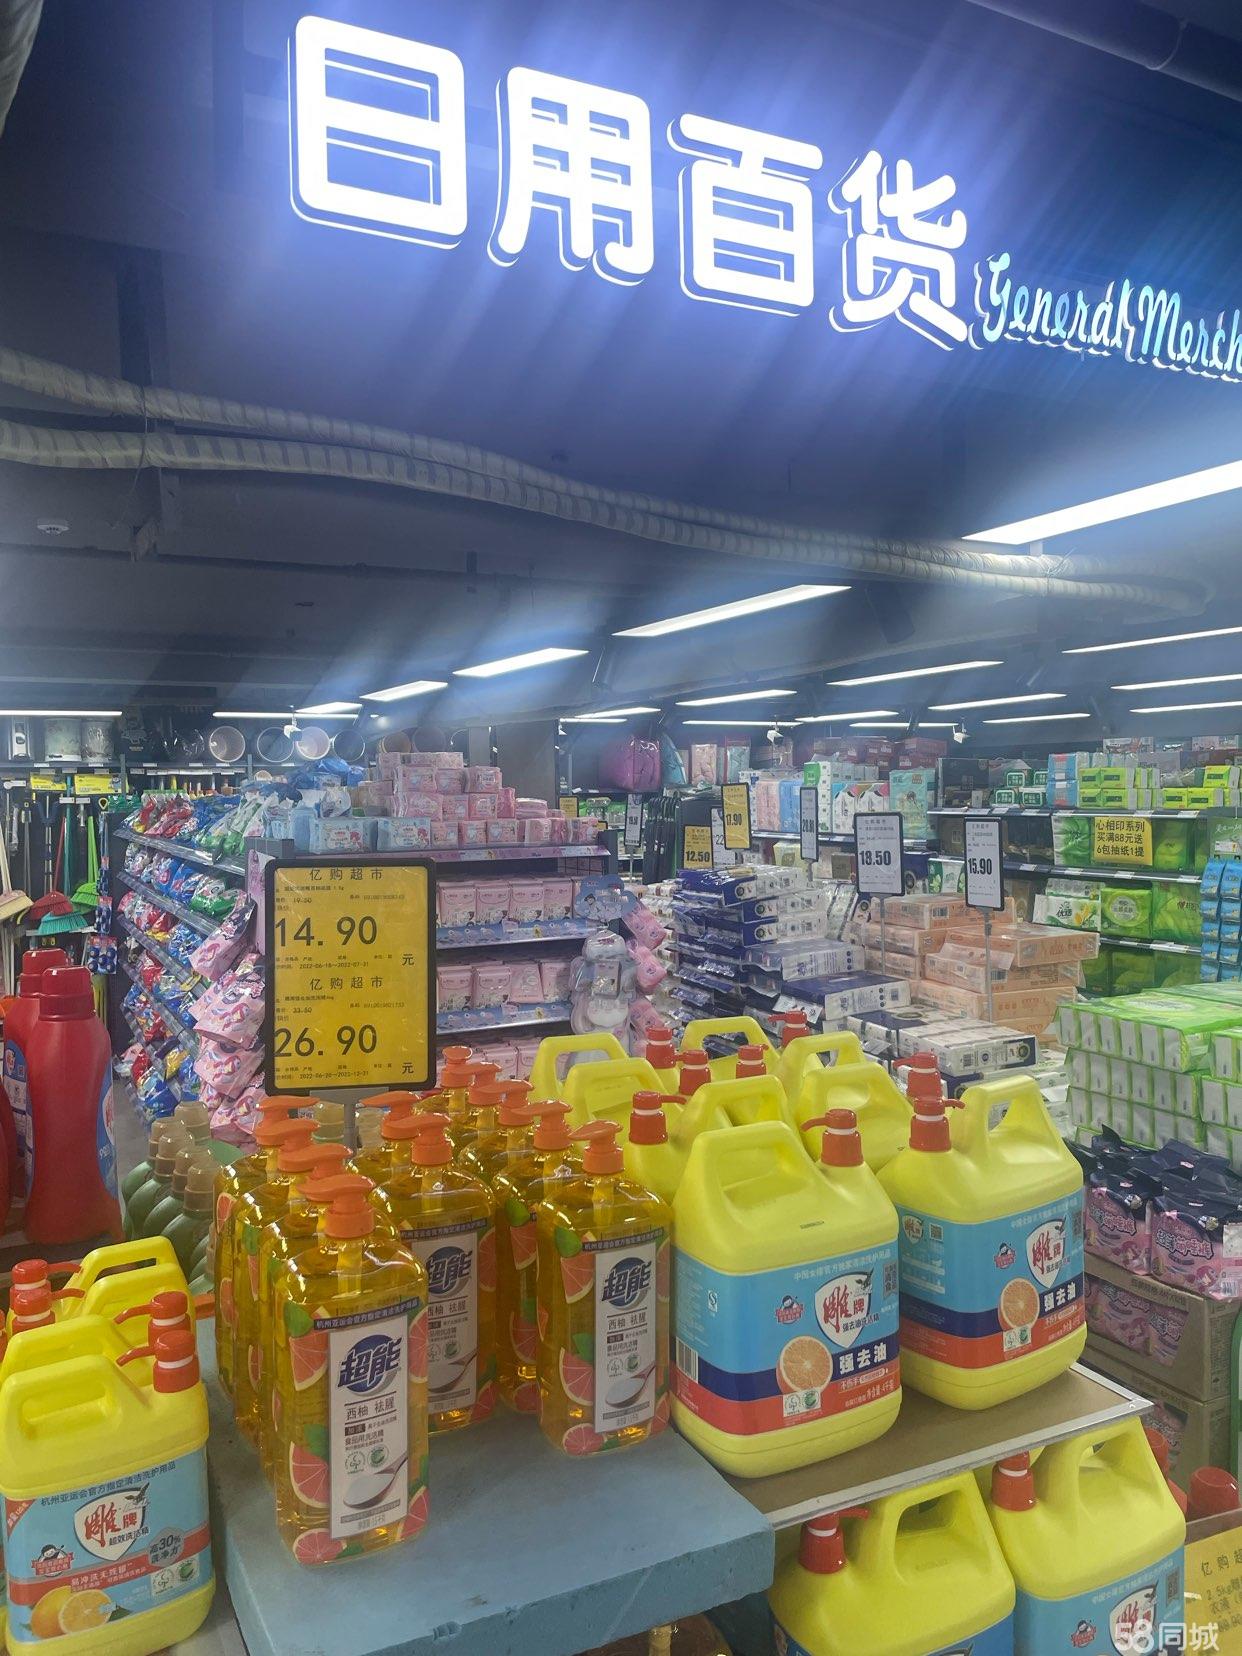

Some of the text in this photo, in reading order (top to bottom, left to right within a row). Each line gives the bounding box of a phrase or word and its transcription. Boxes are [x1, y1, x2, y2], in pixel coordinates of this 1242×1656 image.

[290, 15, 968, 350] 日用百货
[982, 252, 1130, 349] General
[1096, 820, 1145, 832] 心相印系列
[1097, 832, 1143, 844] 买满88元送
[686, 850, 710, 863] 12.50
[1096, 844, 1145, 857] 6包抽纸1提
[309, 869, 383, 881] 亿购超市
[968, 858, 992, 875] 15.90
[275, 915, 377, 947] 14.90
[402, 953, 415, 966] 元
[309, 976, 384, 991] 亿购超市
[275, 1024, 377, 1058] 26.90
[402, 1062, 415, 1074] 元
[601, 1261, 652, 1301] 超能
[1044, 1281, 1076, 1312] 强去油
[823, 1284, 865, 1334] 雕牌
[608, 1317, 626, 1331] 西柚
[337, 1337, 402, 1388] 超能
[839, 1342, 887, 1375] 强去油
[346, 1405, 369, 1420] 西柚
[84, 1502, 138, 1548] 雕牌
